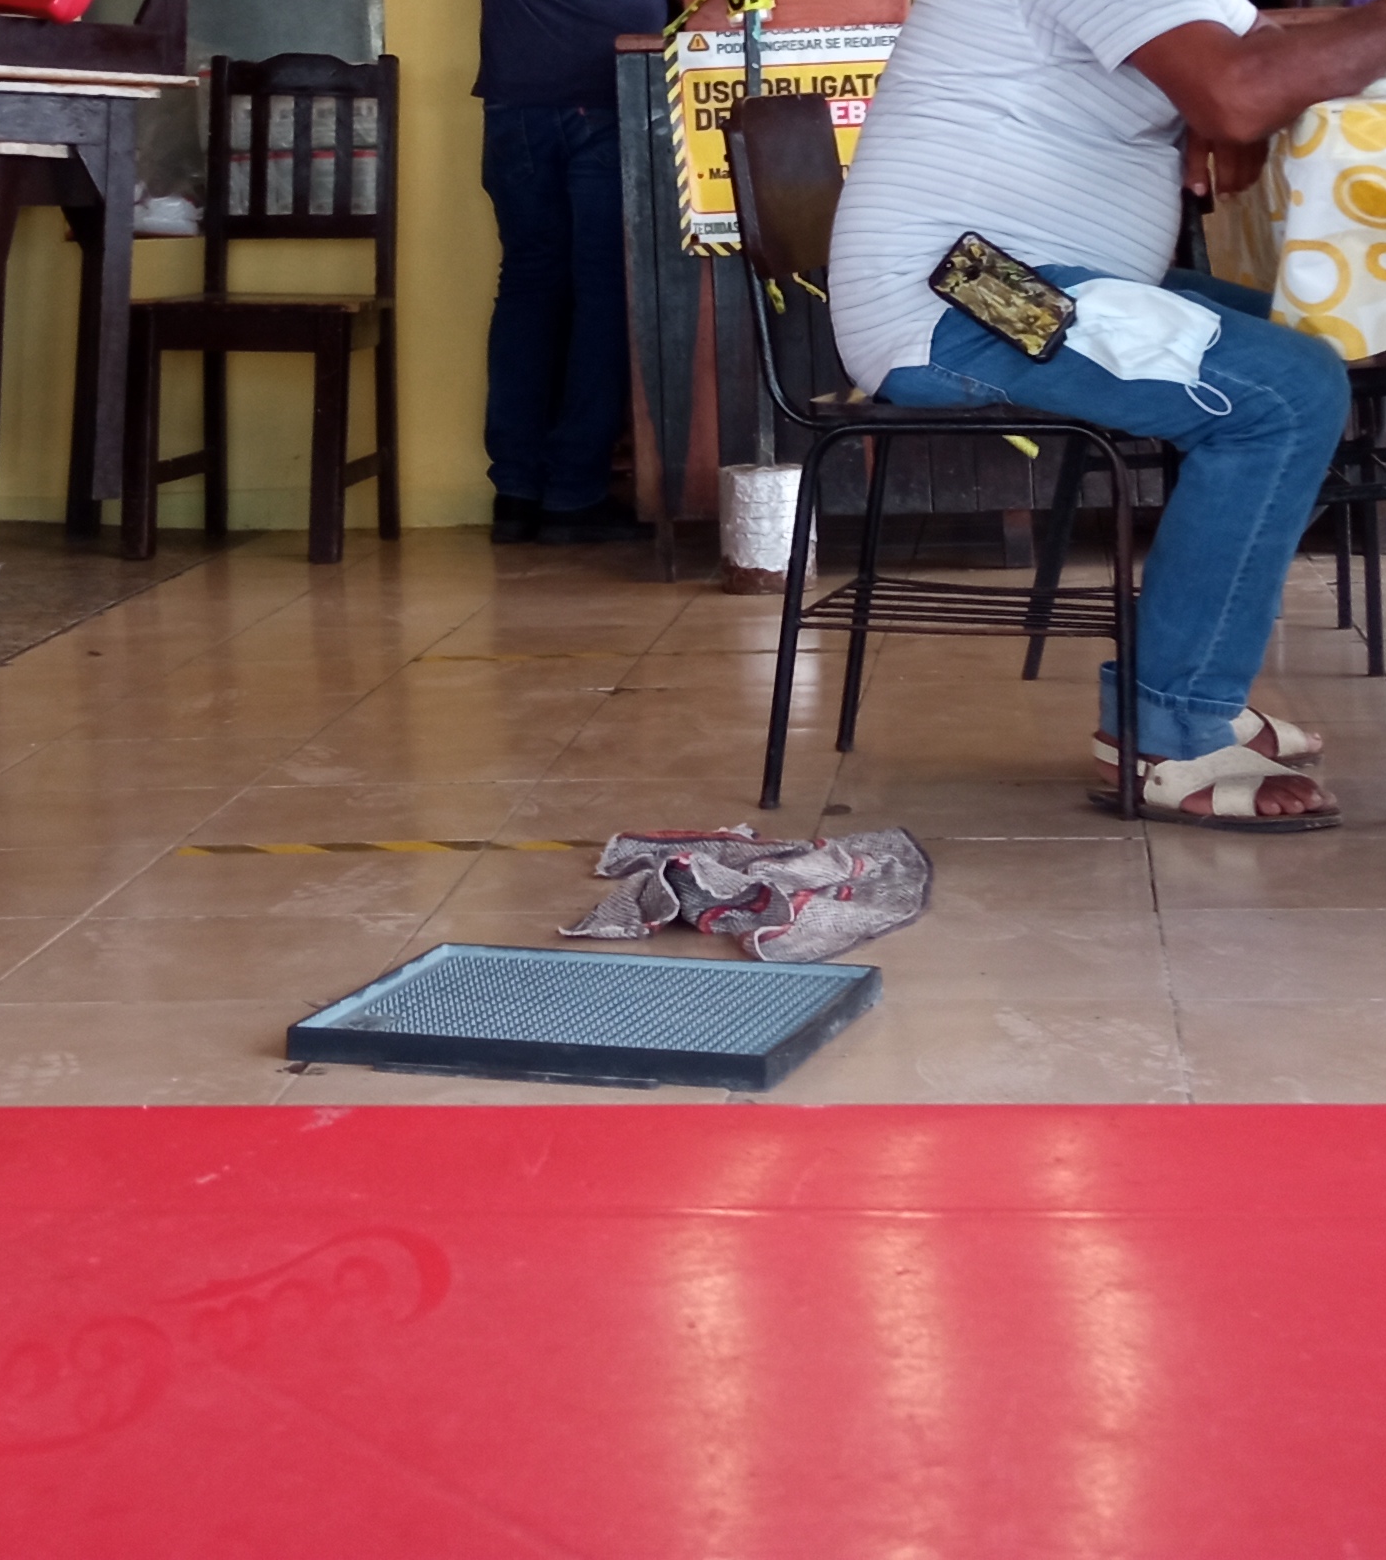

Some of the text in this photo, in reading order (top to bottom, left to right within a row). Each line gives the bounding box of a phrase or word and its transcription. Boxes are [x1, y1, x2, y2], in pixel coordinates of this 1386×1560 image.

[825, 37, 842, 49] SE
[844, 36, 896, 48] REQUIER
[693, 80, 746, 104] USO
